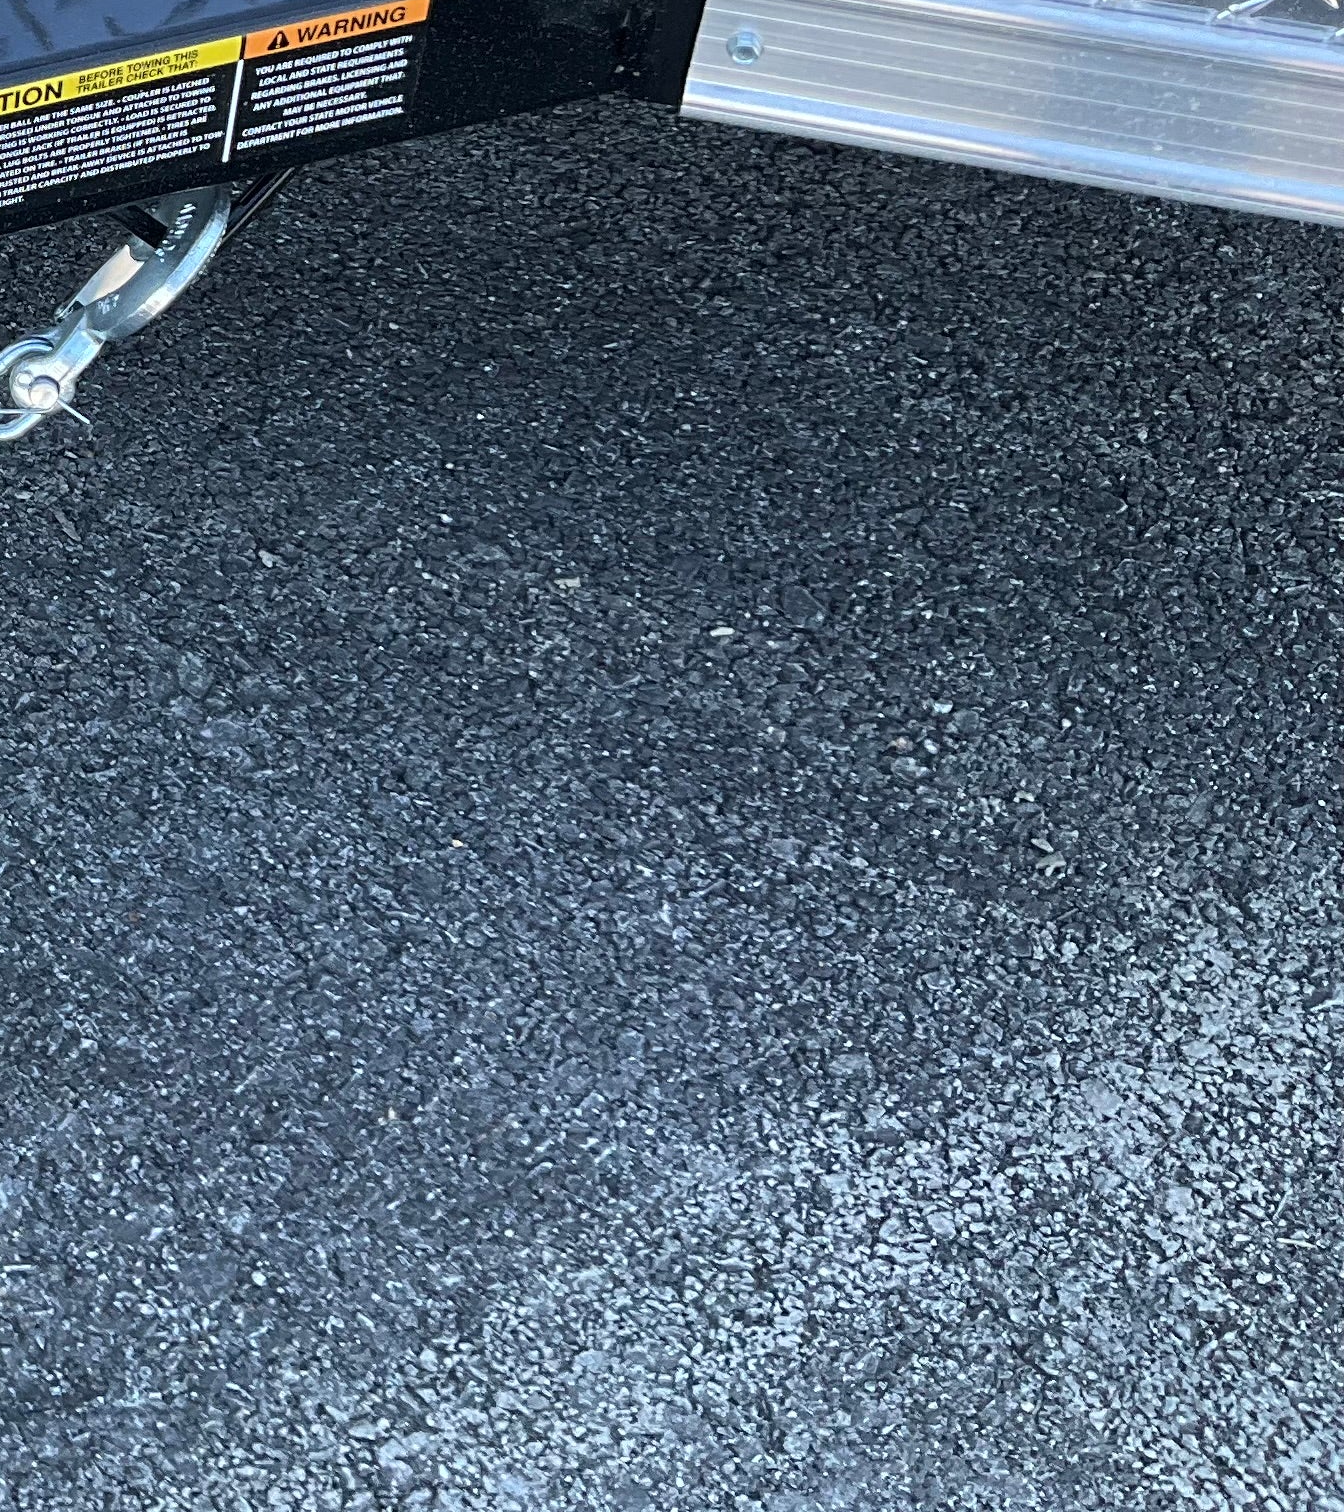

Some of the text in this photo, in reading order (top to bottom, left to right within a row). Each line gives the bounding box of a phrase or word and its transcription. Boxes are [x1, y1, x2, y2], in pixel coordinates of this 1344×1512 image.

[297, 7, 406, 42] WARNING
[79, 50, 198, 84] BEFORE TOWING THIS
[254, 33, 412, 76] YOU ARE REQUIRED TO COMPLY WITH
[76, 76, 123, 95] TRAILER
[126, 68, 163, 84] CHECK
[250, 81, 302, 100] REGARDING
[340, 62, 386, 80] LICENSING
[387, 58, 407, 69] AND
[258, 73, 287, 87] LOCAL
[289, 68, 309, 80] AND
[310, 62, 336, 75] STATE
[252, 100, 272, 112] ANY
[272, 87, 327, 107] ADDITIONAL
[328, 75, 379, 95] EQUIPMENT
[282, 105, 302, 117] MAY
[303, 102, 315, 112] BE
[241, 93, 403, 138] CONTACT YOUR STATE MOTOR VEHICLE
[236, 129, 295, 151] DEPARTMENT
[295, 125, 314, 137] FOR
[314, 119, 339, 133] MORE
